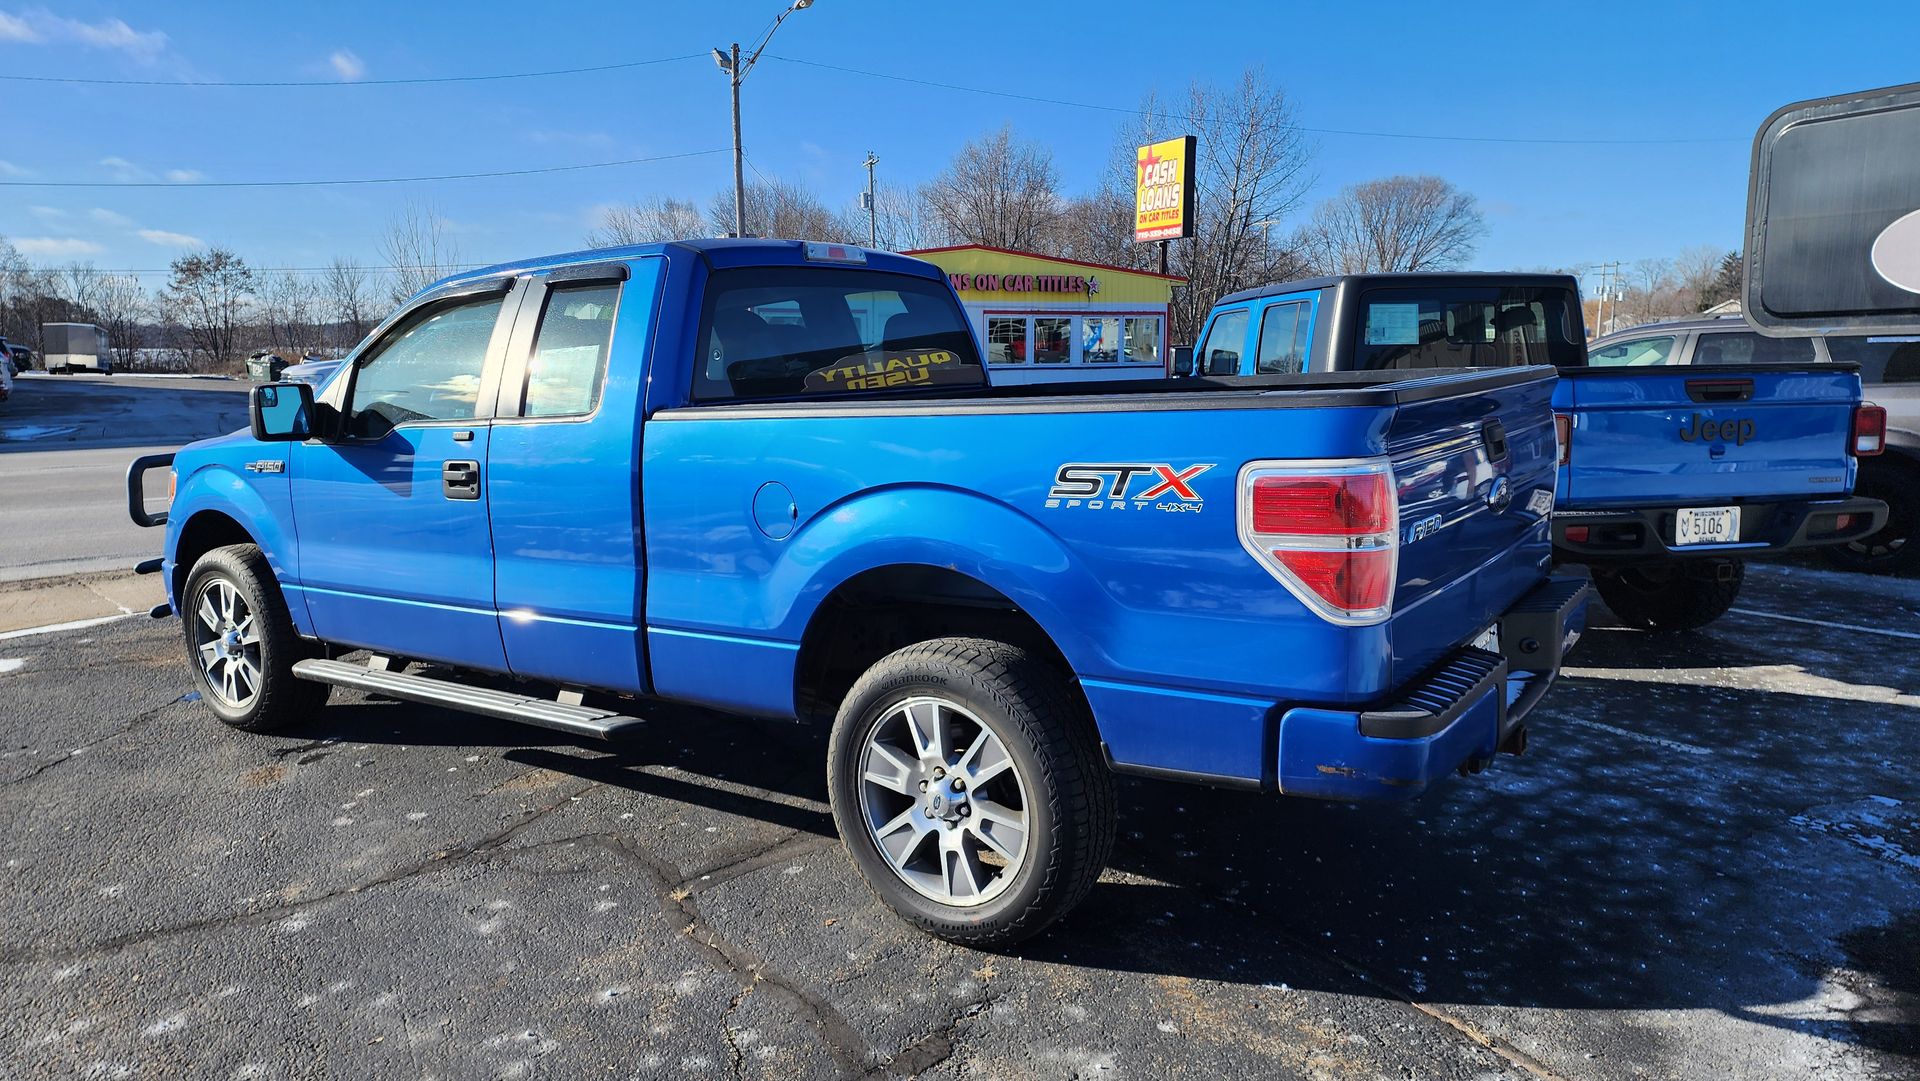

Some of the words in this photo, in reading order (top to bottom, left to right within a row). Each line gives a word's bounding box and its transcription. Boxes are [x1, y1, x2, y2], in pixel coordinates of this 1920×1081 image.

[1144, 158, 1178, 188] CASH
[1139, 183, 1181, 213] LOANS
[1139, 212, 1148, 224] ON
[1149, 211, 1160, 222] CAR
[1161, 208, 1180, 221] TITLES
[975, 274, 999, 291] ON
[1003, 274, 1034, 292] CAR
[1037, 275, 1085, 293] TITLES
[1679, 413, 1756, 447] Jeep
[1048, 462, 1218, 501] STX
[1044, 499, 1149, 511] SPORT
[1694, 517, 1723, 536] 5106
